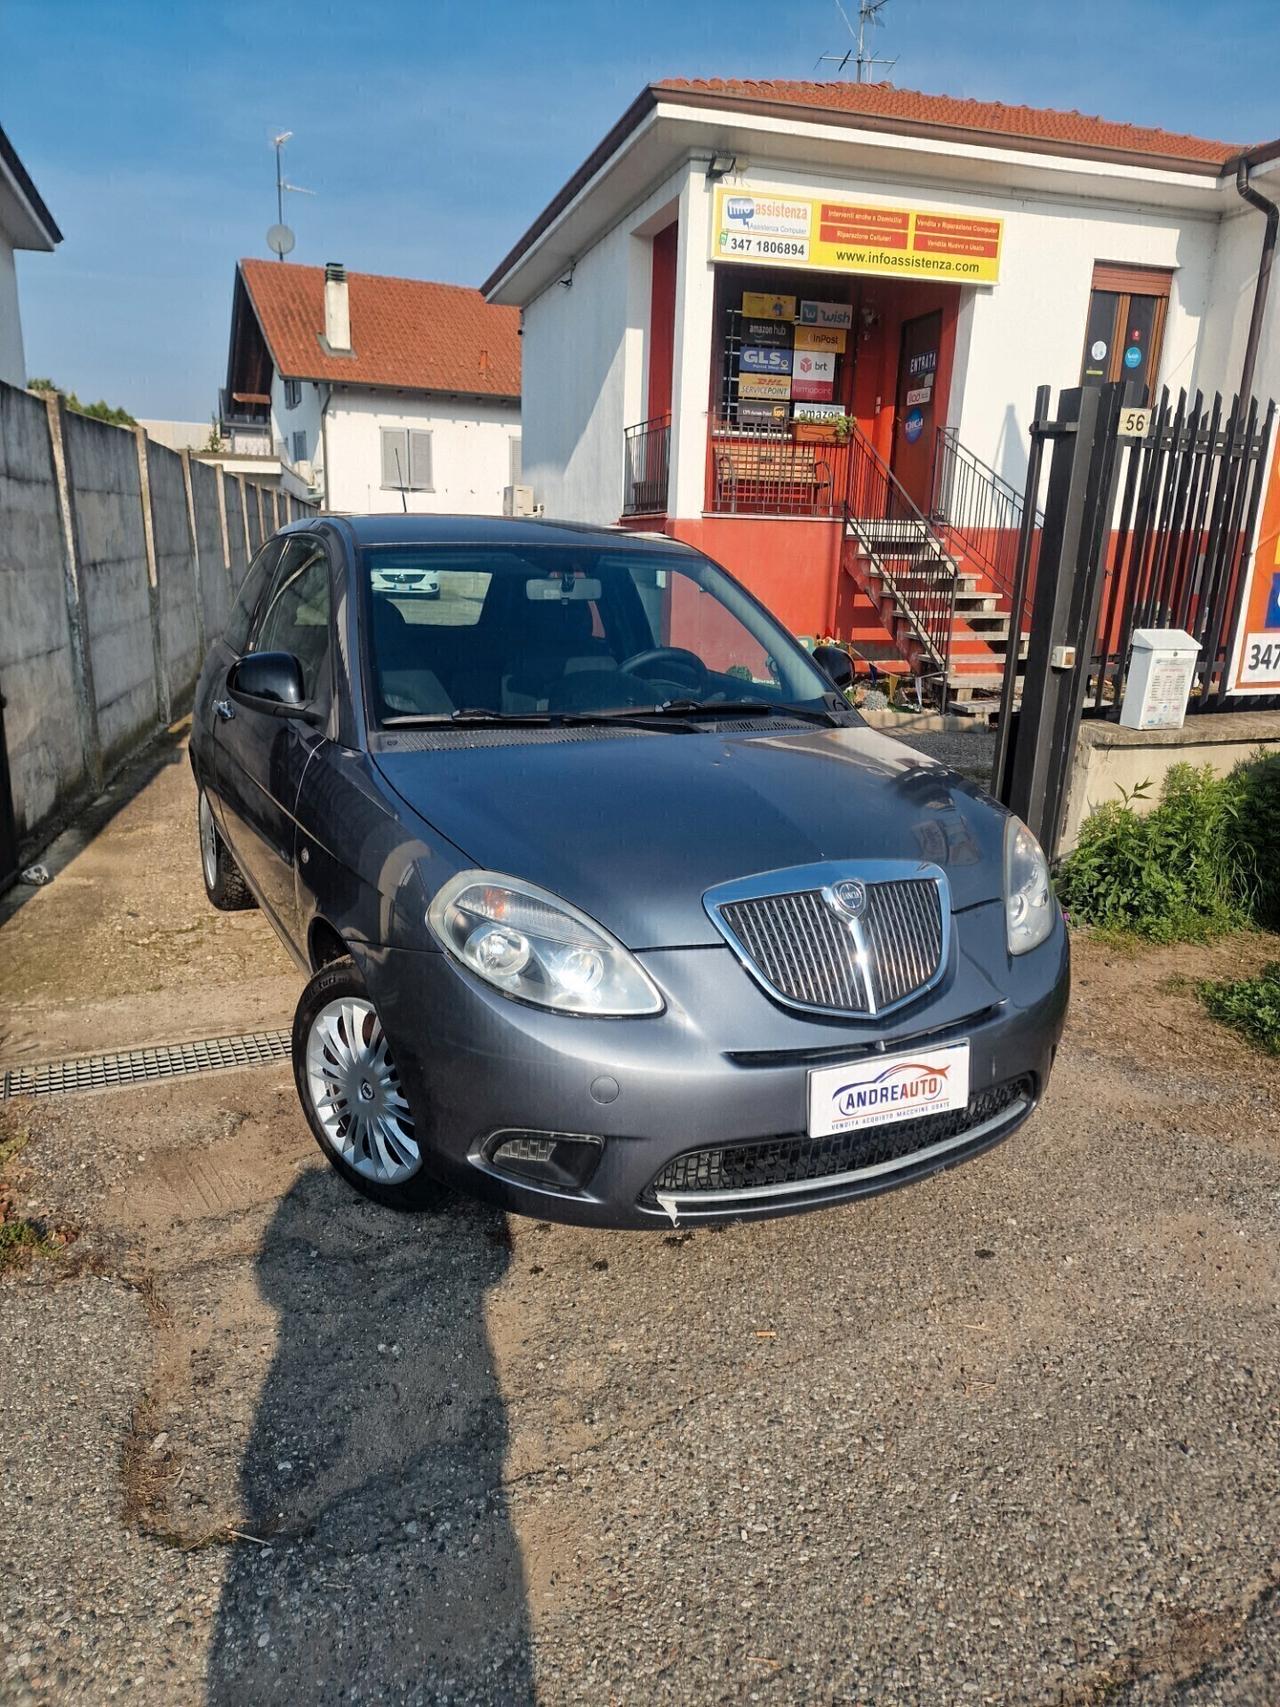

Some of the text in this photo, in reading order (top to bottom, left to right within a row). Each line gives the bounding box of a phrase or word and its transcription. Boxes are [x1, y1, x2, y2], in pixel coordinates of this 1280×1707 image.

[755, 202, 807, 219] assistenza
[828, 210, 854, 219] Interventi
[855, 213, 871, 221] anche
[877, 215, 902, 224] Domicilio
[750, 222, 807, 236] Assistenza Computer
[917, 219, 937, 228] Vendita
[942, 221, 972, 232] Riparazione
[972, 224, 997, 234] Computer
[837, 230, 892, 242] Riparazione Cellulari
[731, 238, 805, 255] 347 1806894
[927, 239, 947, 248] Vendita
[948, 241, 964, 249] Nuovo
[836, 251, 980, 273] www.infoassistenza.com
[749, 324, 786, 335] amazon hub
[813, 334, 839, 344] InPost
[743, 350, 781, 365] GLS
[910, 352, 936, 373] ENTRATA
[815, 362, 828, 371] brt
[756, 377, 783, 386] DHL
[1126, 414, 1145, 432] 56
[845, 1077, 938, 1110] ANDREAUTO
[832, 1101, 950, 1130] VENDITA ACQUISTO MACCHINE USATE
